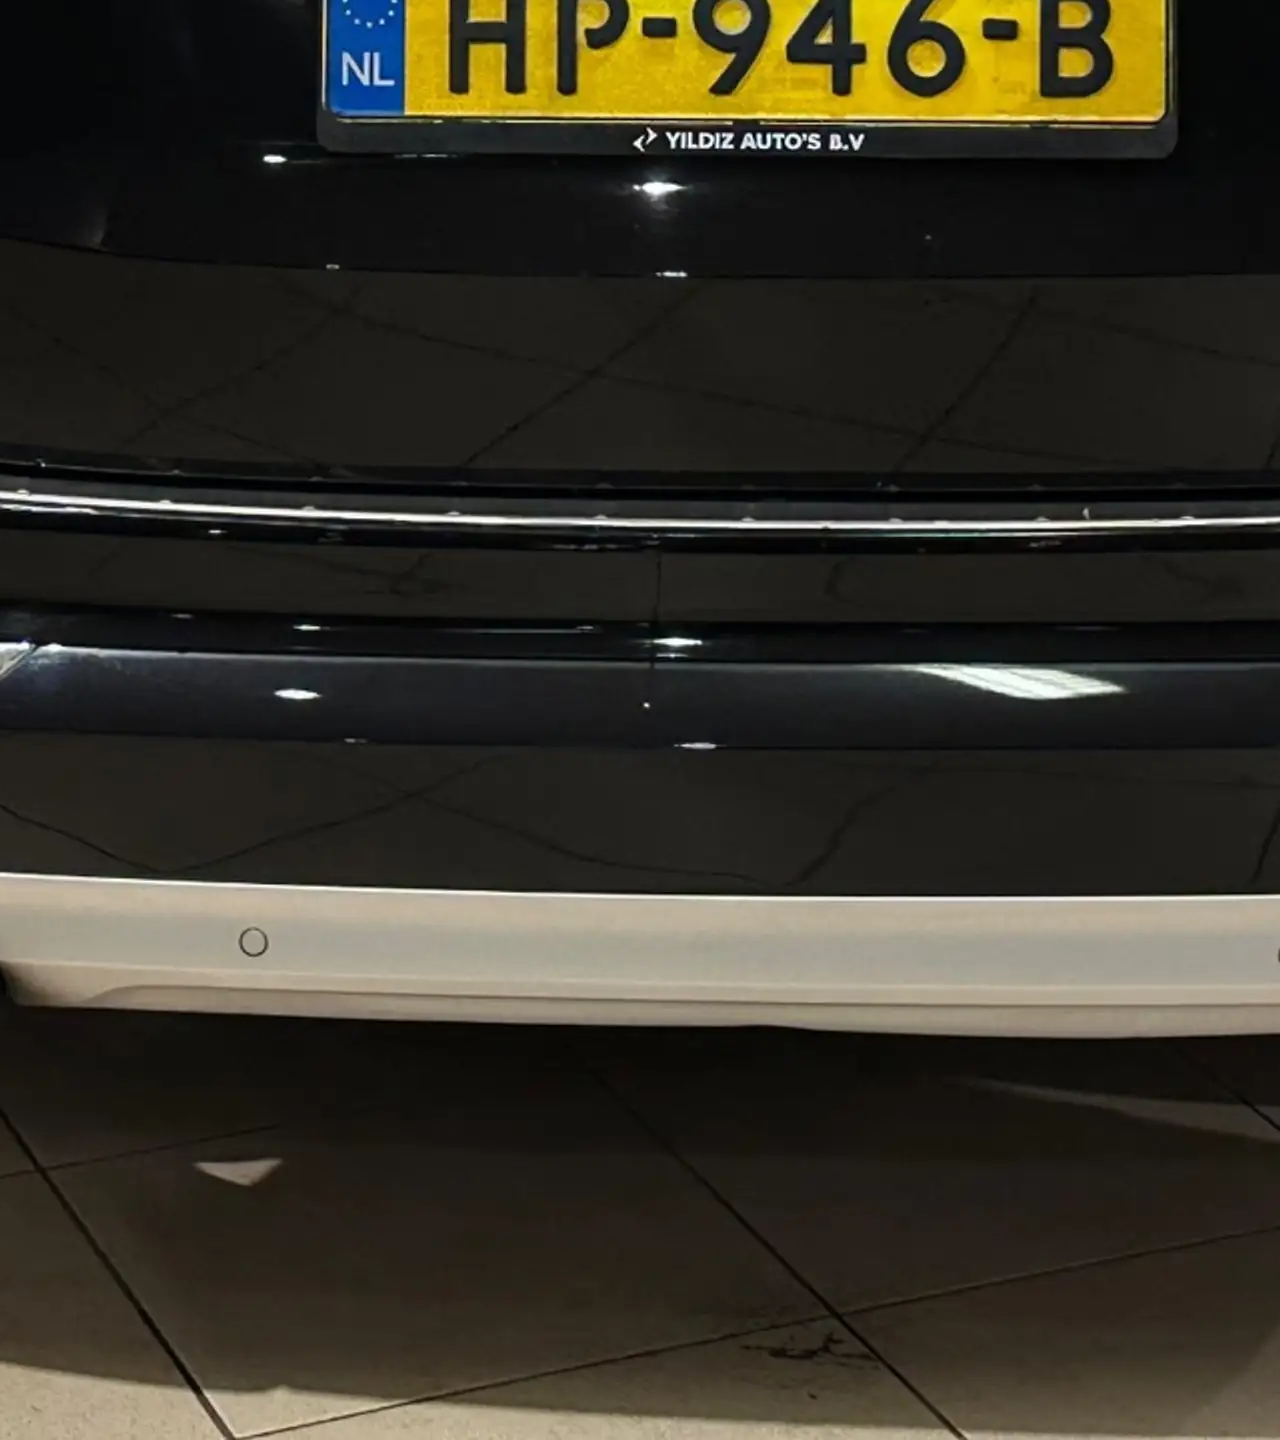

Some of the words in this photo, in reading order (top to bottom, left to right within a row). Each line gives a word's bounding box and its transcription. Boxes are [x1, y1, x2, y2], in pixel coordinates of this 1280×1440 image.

[341, 51, 396, 87] NL
[665, 130, 735, 151] YILDIZ
[739, 131, 822, 151] AUTO'S
[828, 132, 866, 152] B.V
